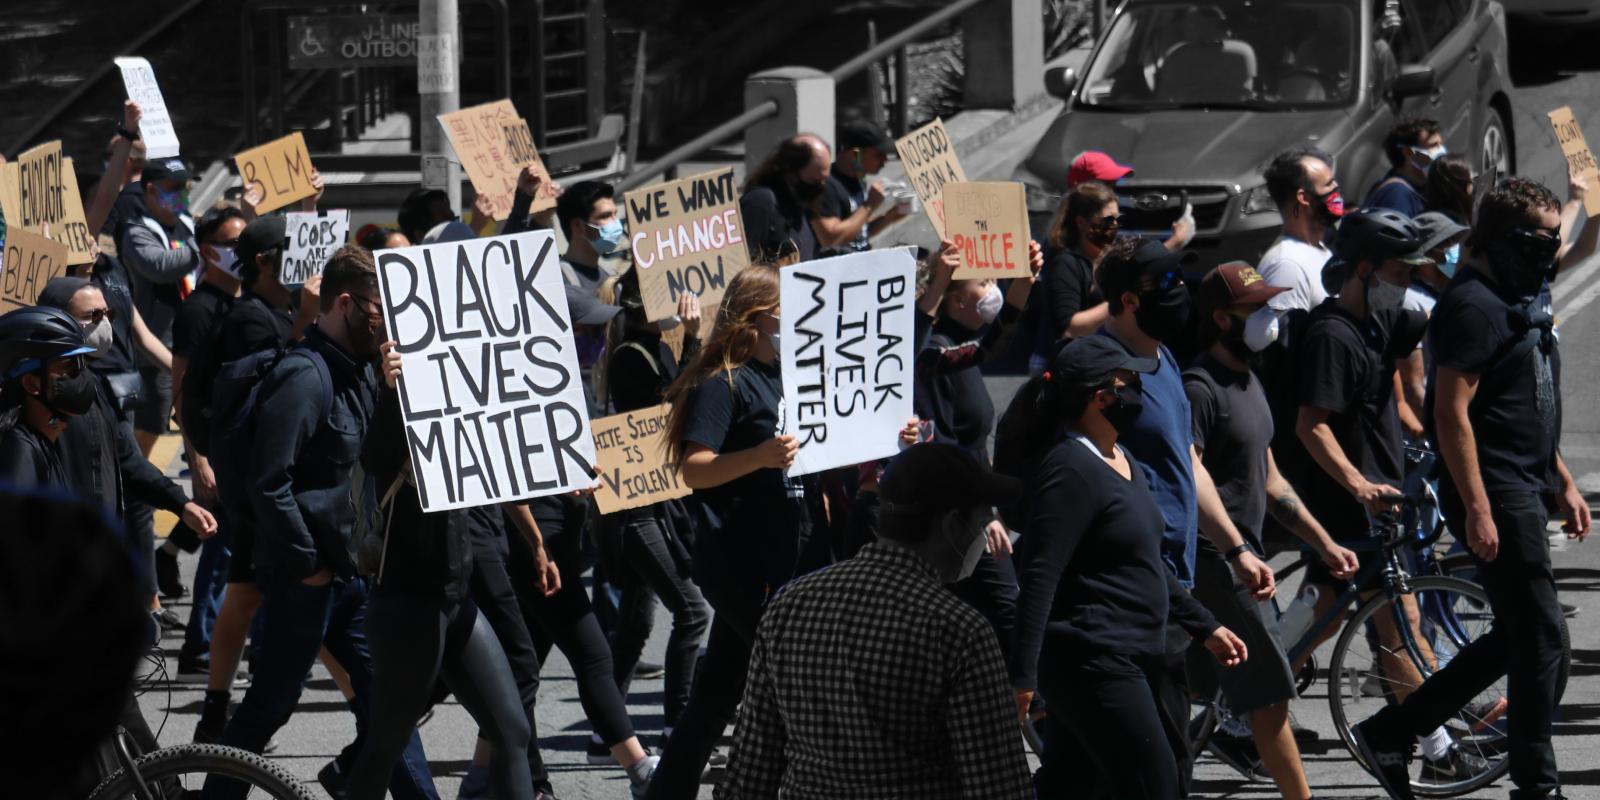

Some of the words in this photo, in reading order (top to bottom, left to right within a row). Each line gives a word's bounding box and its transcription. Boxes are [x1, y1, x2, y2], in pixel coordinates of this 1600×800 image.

[900, 140, 921, 170] NO
[916, 125, 948, 163] GOOD
[945, 159, 960, 183] A
[21, 151, 64, 227] ENOUGH
[244, 145, 311, 202] BLM
[630, 191, 669, 224] WE
[677, 171, 734, 213] WANT
[298, 220, 337, 248] COPS
[632, 209, 742, 269] CHANGE
[953, 232, 1016, 270] POLICE
[974, 220, 988, 232] THE
[306, 247, 328, 261] ARE
[666, 255, 725, 303] NOW
[378, 236, 568, 354] BLACK
[793, 271, 827, 449] MATTER
[834, 280, 868, 418] LIVES
[874, 275, 905, 412] BLACK
[398, 335, 570, 422] LIVES
[406, 401, 598, 509] MATTER
[593, 427, 624, 451] HITE
[622, 445, 644, 463] IS
[601, 463, 679, 499] VIOLENT
